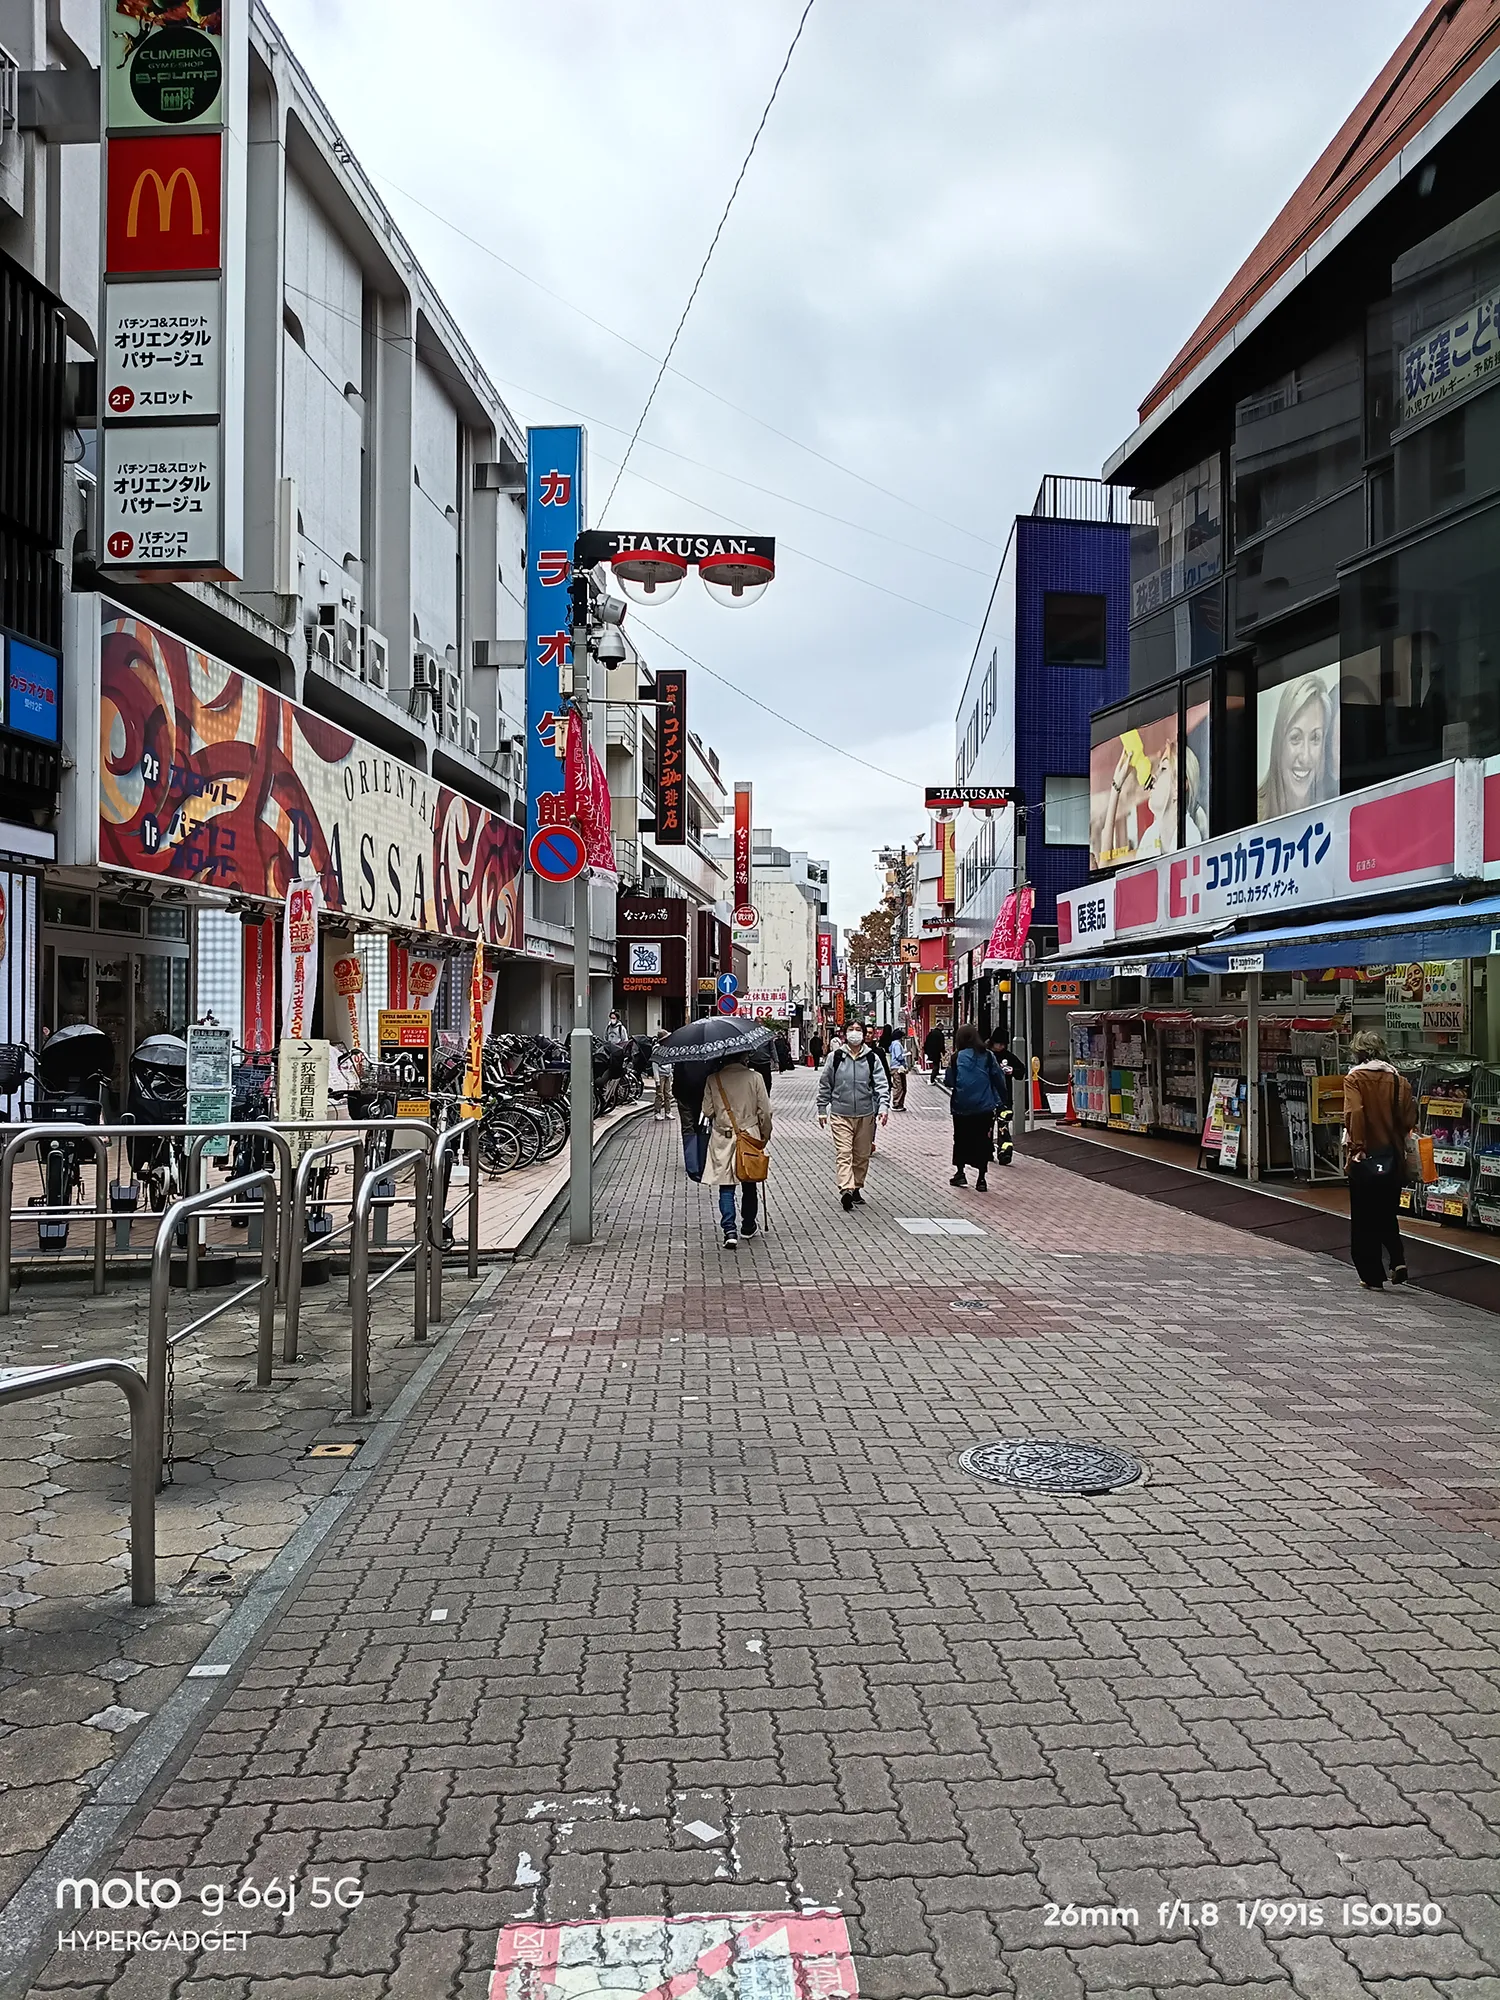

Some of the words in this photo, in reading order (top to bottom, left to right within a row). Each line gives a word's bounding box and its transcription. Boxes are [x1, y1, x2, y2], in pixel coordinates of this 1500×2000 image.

[140, 47, 212, 60] CLIMBING
[183, 87, 195, 99] 3F
[118, 315, 208, 329] パチンコ&スロット
[114, 330, 212, 349] オリエンタル
[121, 350, 204, 368] パサージュ
[112, 393, 131, 405] 2F
[139, 390, 193, 405] スロット
[117, 462, 207, 474] パチンコ&スロット
[113, 476, 211, 494] オリエンタル
[120, 496, 203, 514] パサージュ
[111, 540, 130, 551] 1F
[138, 531, 188, 544] パチンコ
[138, 546, 187, 558] スロット
[10, 674, 55, 705] カラオケ館
[143, 752, 160, 781] 2F
[169, 763, 237, 806] スロット
[660, 717, 682, 830] コメダ珈琲店
[343, 758, 437, 835] ORIENTAL
[144, 819, 158, 848] 1F
[168, 811, 237, 852] パチンコ
[169, 841, 237, 878] スロット
[736, 826, 749, 885] なごみの湯
[1206, 821, 1332, 891] ココカラファイン
[284, 807, 473, 935] PASSAGE
[1226, 878, 1299, 906] ココロ、カラダ、ゲンキ。
[623, 908, 668, 921] なごみの湯
[1077, 898, 1107, 933] 医薬品
[1424, 963, 1446, 977] NEW
[410, 979, 430, 990] 周年
[756, 1006, 773, 1017] 62
[785, 1002, 797, 1016] P
[1386, 1011, 1401, 1020] Hits
[1386, 1020, 1421, 1029] Different
[1423, 1011, 1461, 1028] INJESK
